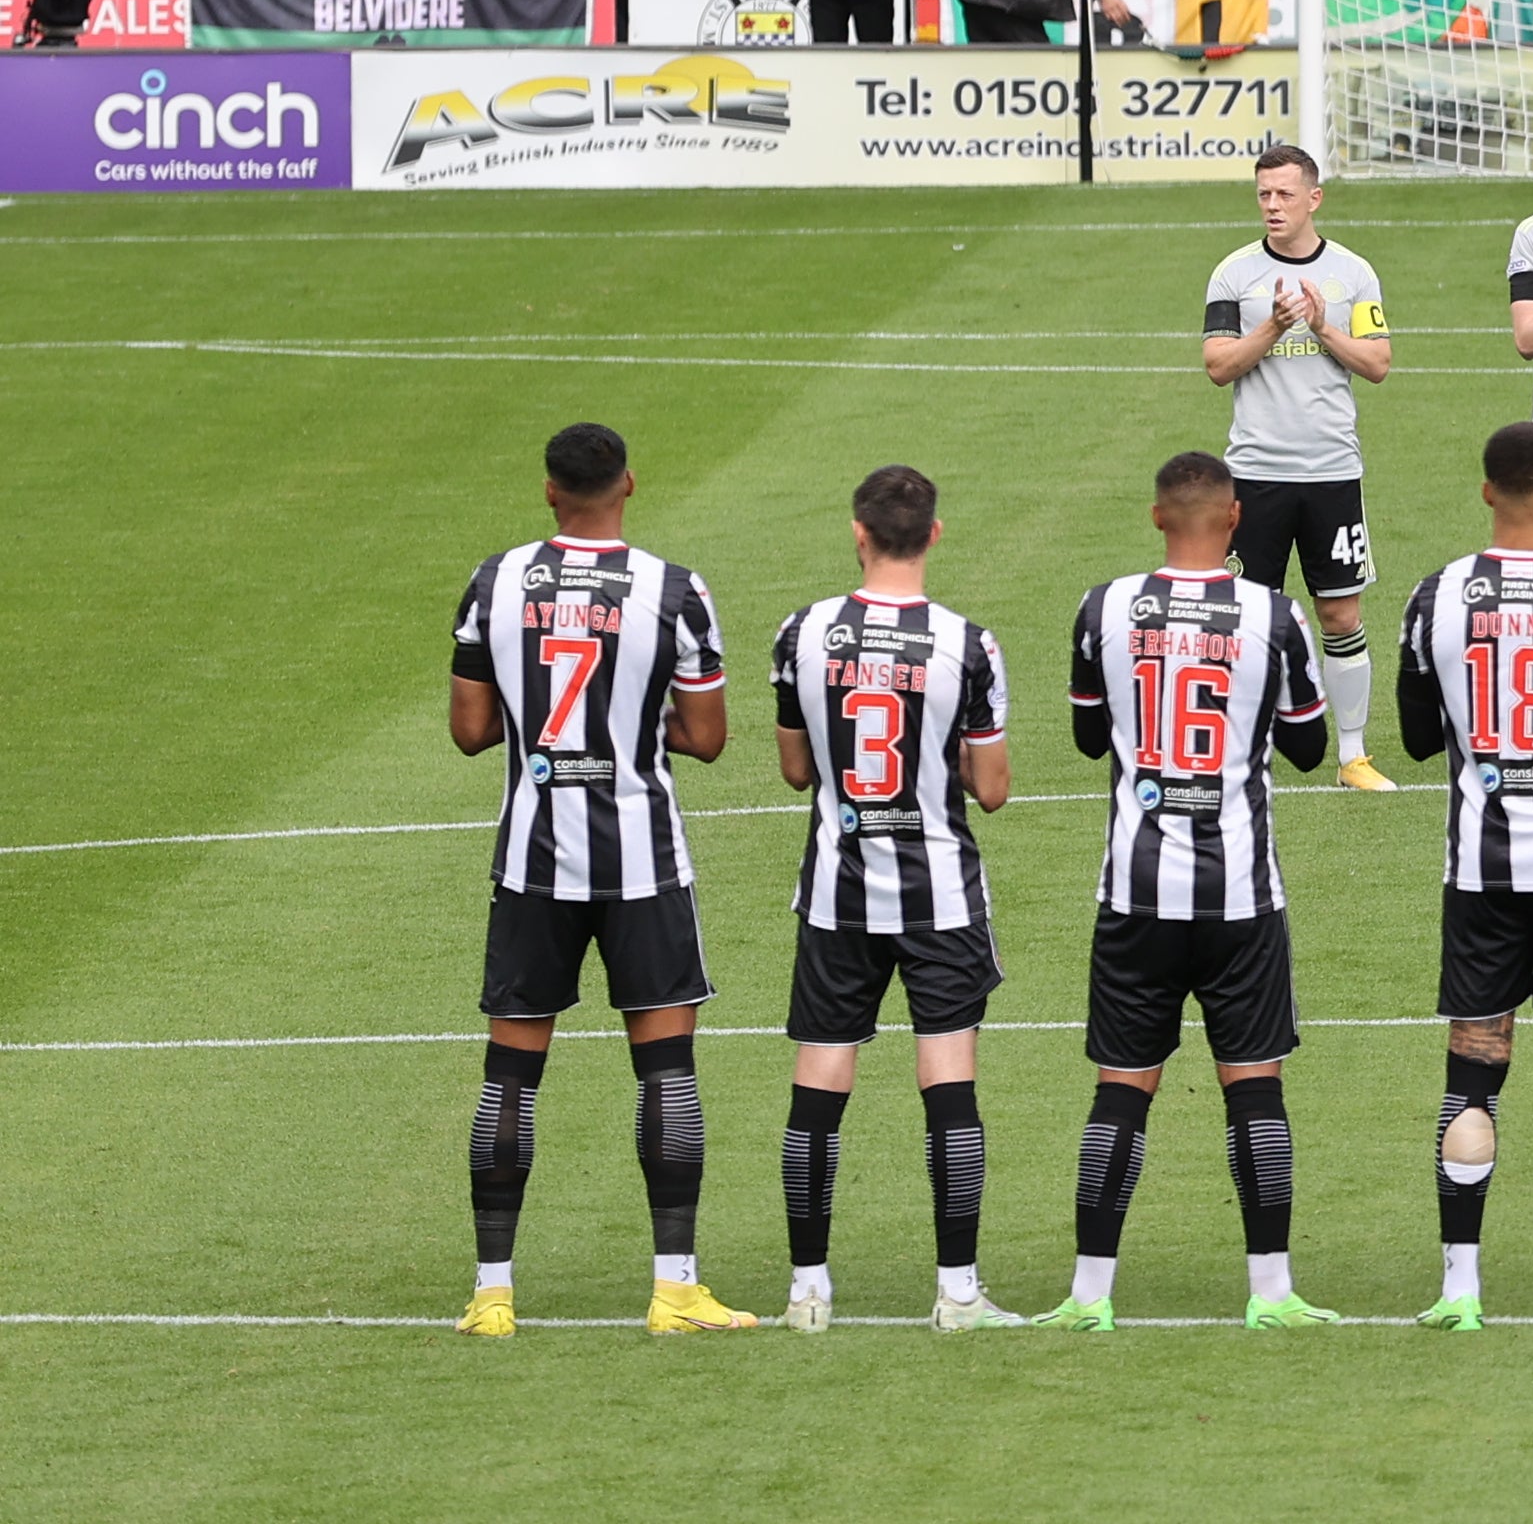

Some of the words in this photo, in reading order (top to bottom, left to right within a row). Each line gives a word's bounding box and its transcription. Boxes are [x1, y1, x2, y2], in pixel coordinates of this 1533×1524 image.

[94, 68, 320, 150] cinch
[855, 78, 932, 116] Tel:
[1121, 80, 1289, 117] 327711
[382, 74, 791, 174] ACRE
[94, 159, 148, 181] Cars
[149, 159, 235, 181] without
[237, 159, 274, 179] the
[276, 157, 320, 179] faff
[403, 160, 478, 185] Serving
[485, 146, 554, 169] British
[560, 135, 647, 156] Industry
[654, 132, 710, 148] Since
[720, 137, 779, 153] 1989
[1370, 304, 1384, 328] C
[1331, 522, 1366, 566] 42
[560, 577, 602, 588] LEASING
[561, 568, 589, 577] FIRST
[590, 570, 631, 583] VEHICLE
[1501, 581, 1533, 591] FIRST
[523, 602, 620, 633] AYUNGA
[1168, 610, 1211, 621] LEASING
[1169, 601, 1201, 611] FIRST
[1202, 604, 1240, 614] VEHICLE
[862, 639, 904, 650] LEASING
[863, 628, 891, 638] FIRST
[892, 631, 934, 644] VEHICLE
[1128, 629, 1243, 661] ERHAHON
[826, 660, 927, 692] TANSER
[537, 636, 603, 746] 7
[1132, 658, 1232, 775] 16
[842, 689, 904, 799] 3
[554, 757, 613, 769] consilium
[1164, 786, 1220, 798] consilium
[861, 808, 920, 820] consilium
